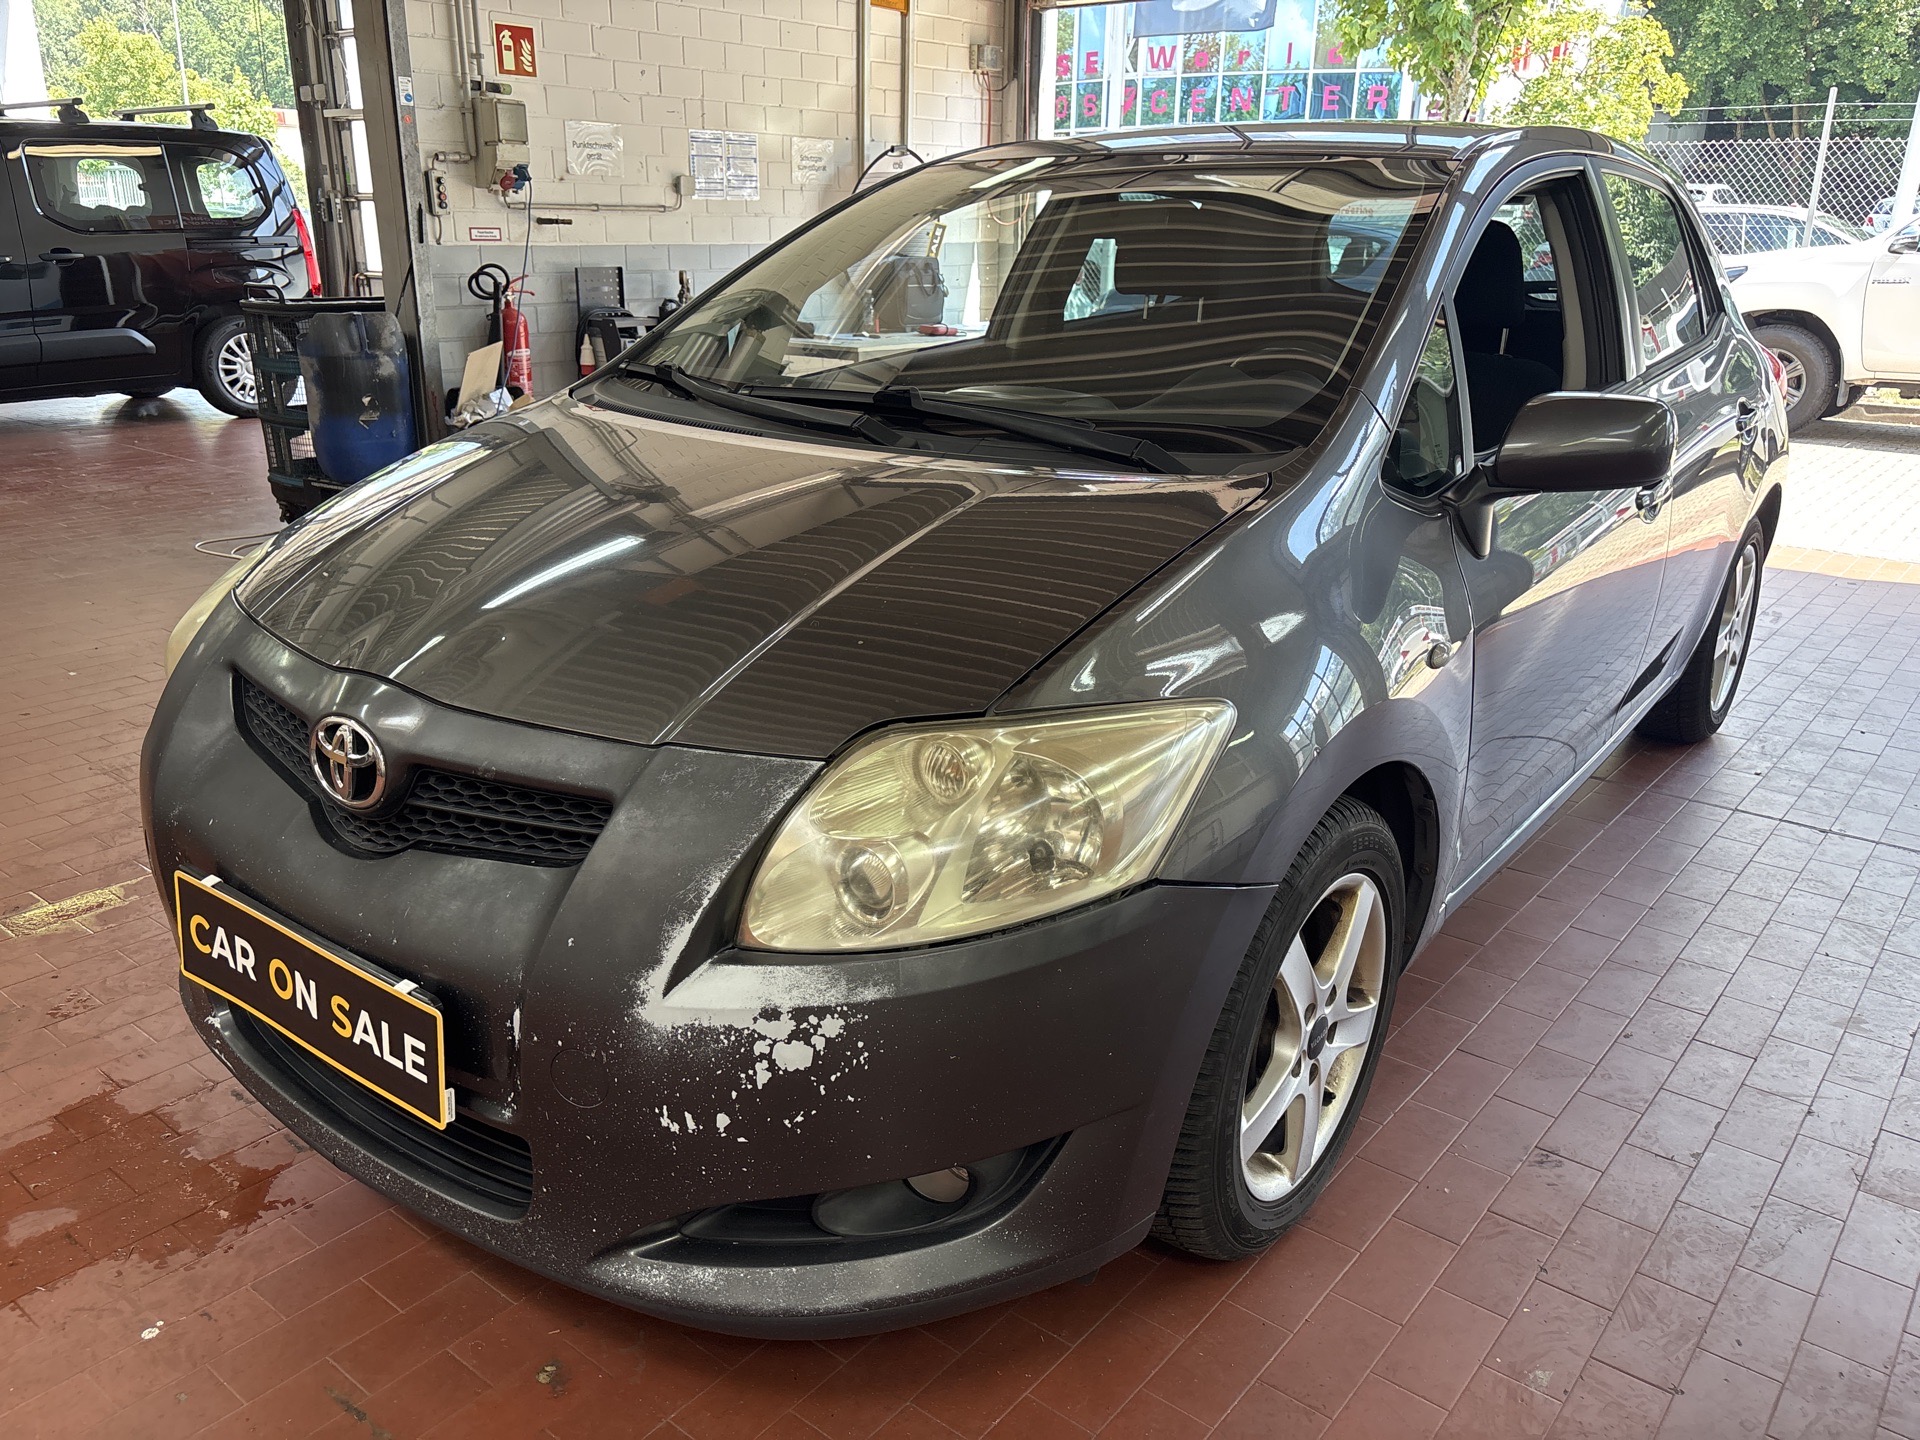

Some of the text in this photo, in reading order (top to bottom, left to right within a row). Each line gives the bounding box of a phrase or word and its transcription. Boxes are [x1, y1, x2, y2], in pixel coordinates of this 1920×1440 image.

[1150, 85, 1390, 114] CENTER
[189, 914, 429, 1084] CAR ON SALE
